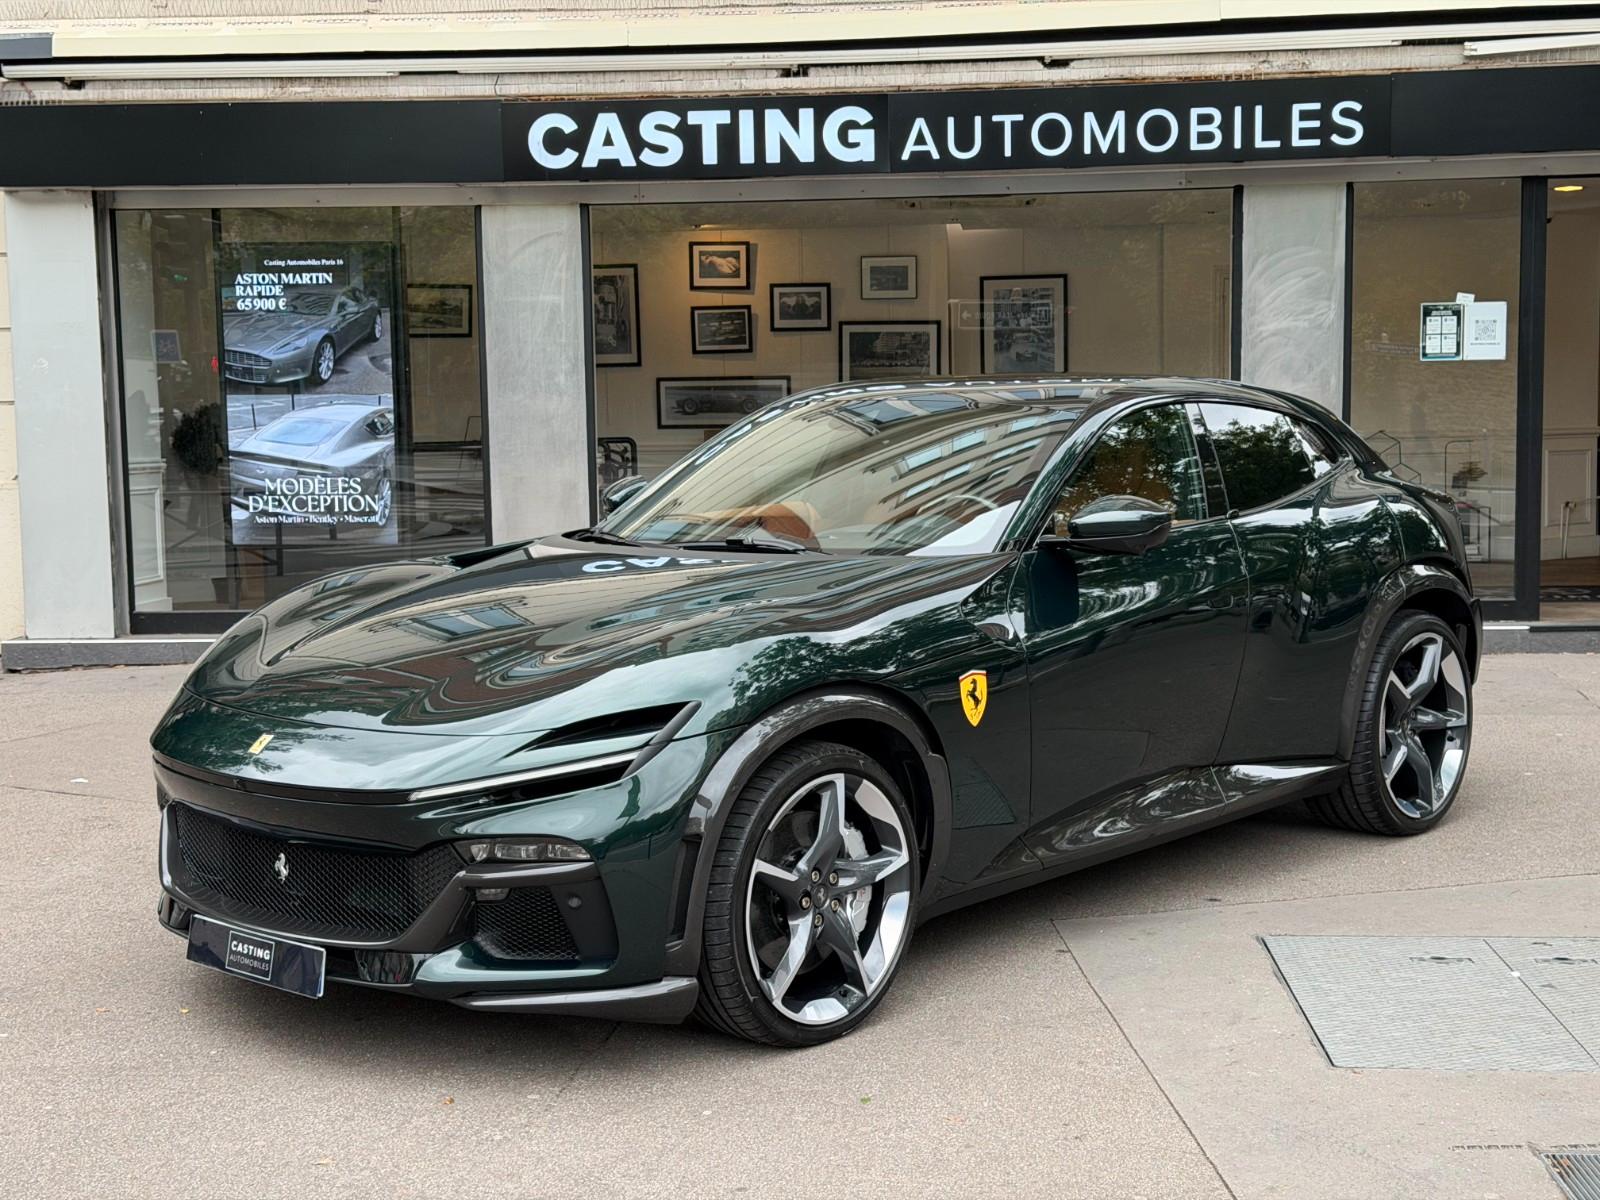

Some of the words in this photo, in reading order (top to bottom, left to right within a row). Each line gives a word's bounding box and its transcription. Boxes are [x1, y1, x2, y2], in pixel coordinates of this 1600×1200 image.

[528, 105, 875, 169] CASTING
[901, 101, 1364, 160] AUTOMOBILES
[263, 259, 286, 267] Casting
[235, 273, 278, 284] ASTON
[281, 272, 333, 284] MARTIN
[235, 285, 284, 296] RAPIDE
[264, 474, 362, 495] MODÈLES
[248, 494, 379, 513] D'EXCEPTION
[255, 514, 277, 523] Aston
[278, 514, 304, 523] Martin
[309, 514, 337, 525] Bentley
[231, 941, 271, 960] CASTING
[229, 953, 270, 972] AUTOMOBILES
